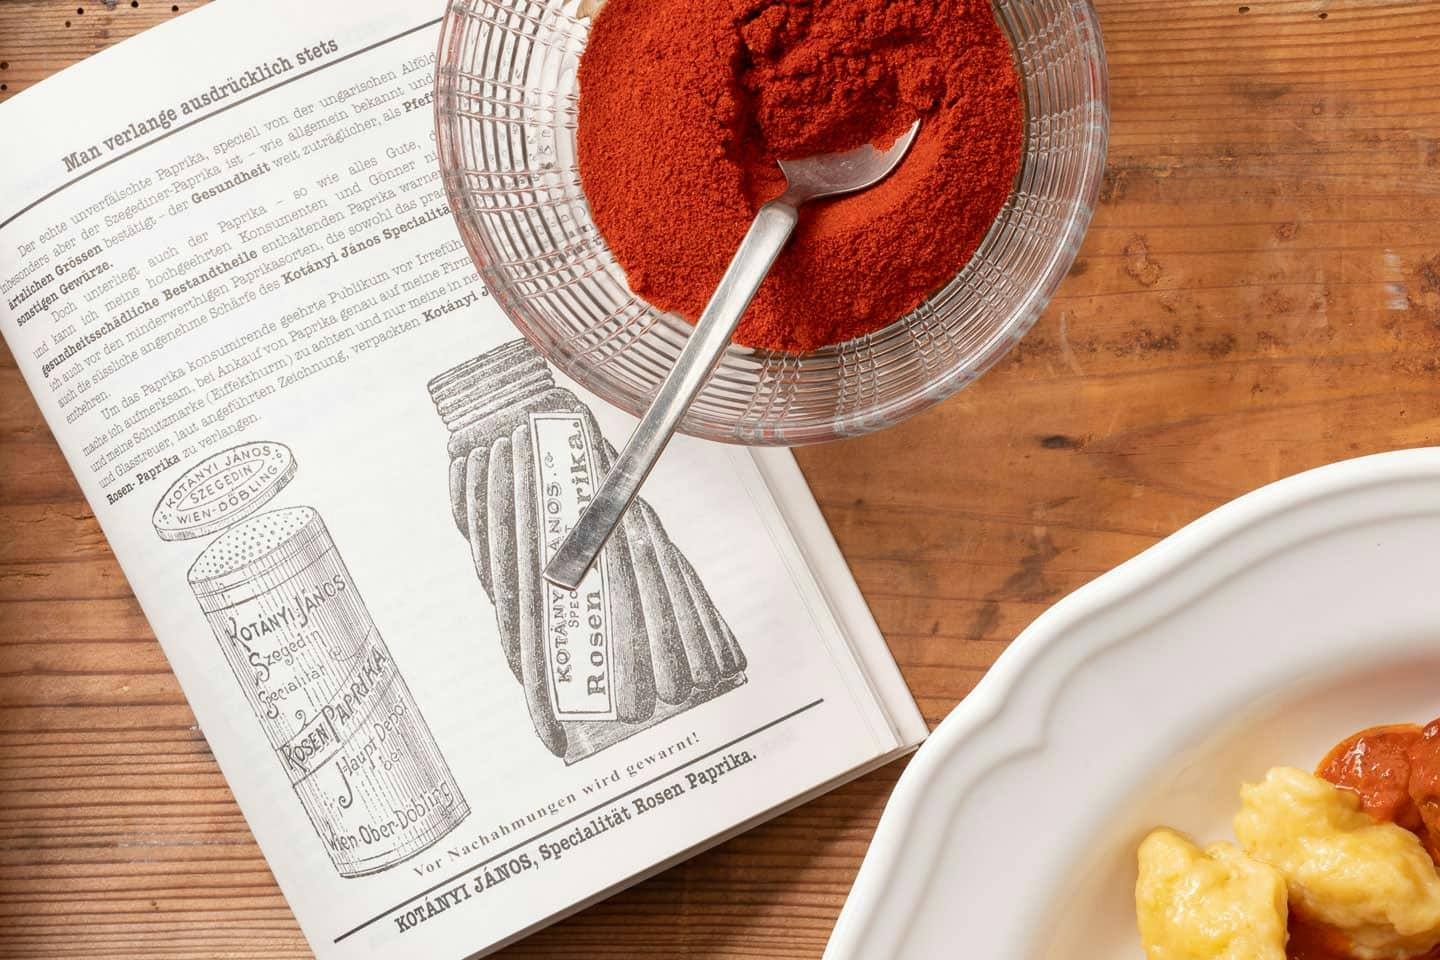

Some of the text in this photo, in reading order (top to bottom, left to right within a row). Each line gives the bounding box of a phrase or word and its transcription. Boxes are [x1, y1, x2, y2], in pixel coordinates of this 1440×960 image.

[17, 240, 36, 258] Der
[39, 222, 68, 244] echte
[70, 178, 152, 224] unverfälschte
[155, 153, 209, 180] Paprika,
[213, 126, 261, 155] speciell
[264, 116, 289, 131] von
[293, 104, 314, 118] der
[319, 72, 397, 108] ungarischen
[52, 238, 76, 257] aber
[81, 224, 100, 240] der
[104, 166, 222, 227] Szegediner-Paprika
[225, 155, 243, 168] ist
[260, 138, 284, 152] wie
[288, 110, 349, 141] allgemein
[351, 86, 404, 114] bekannt
[408, 72, 436, 90] und
[61, 39, 338, 173] Man verlange ausdrücklich stets
[32, 340, 50, 360] und
[50, 324, 77, 345] kann
[81, 310, 99, 326] ich
[104, 288, 140, 312] meine
[145, 242, 232, 288] hochgeehrten
[238, 200, 328, 244] Konsumenten
[335, 182, 362, 200] und
[368, 161, 415, 186] Gönner
[50, 302, 78, 324] Doch
[83, 266, 140, 302] unterliegt
[148, 248, 179, 268] auch
[188, 232, 208, 247] der
[216, 206, 267, 233] Paprika
[293, 188, 308, 199] so
[316, 173, 340, 188] wie
[348, 157, 378, 176] alles
[386, 142, 421, 159] Gute,
[54, 245, 104, 276] Grössen
[102, 216, 156, 248] bestätigt
[168, 200, 189, 216] der
[191, 162, 271, 204] Gesundheit
[272, 150, 300, 167] weit
[382, 108, 402, 122] als
[16, 262, 114, 328] sonstigen Gewürze.
[42, 298, 160, 378] gesundheitsschädliche
[161, 250, 258, 301] Bestandtheile
[262, 212, 345, 253] enthaltenden
[346, 190, 397, 215] Paprika
[49, 377, 63, 392] ich
[62, 362, 84, 382] auch
[83, 352, 101, 366] vor
[104, 338, 125, 355] den
[326, 231, 346, 245] die
[348, 208, 394, 236] sowohl
[395, 200, 418, 215] das
[58, 388, 78, 408] auch
[77, 379, 92, 394] die
[140, 315, 208, 356] angenehme
[209, 291, 256, 319] Schärfe
[259, 280, 280, 295] des
[280, 252, 339, 285] Kotányi
[340, 235, 381, 258] János
[100, 405, 120, 420] Um
[122, 392, 140, 408] das
[140, 368, 186, 397] Paprika
[186, 322, 277, 372] konsumirende
[280, 300, 326, 328] geehrte
[328, 272, 391, 304] Publikum
[392, 260, 413, 275] vor
[108, 424, 124, 439] ich
[124, 386, 195, 429] aufmerksam,
[194, 372, 216, 388] bei
[218, 347, 262, 378] Ankauf
[263, 338, 288, 354] von
[288, 315, 338, 342] Paprika
[340, 297, 378, 322] genau
[379, 284, 400, 302] auf
[401, 270, 440, 292] meine
[66, 392, 111, 424] entbehren.
[90, 454, 108, 472] und
[105, 440, 133, 462] meine
[132, 399, 205, 444] Schutzmarke
[294, 348, 312, 360] zu
[312, 328, 355, 352] achten
[355, 312, 382, 332] und
[382, 304, 406, 320] nur
[408, 286, 446, 308] meine
[447, 280, 462, 292] in
[98, 470, 116, 488] und
[114, 438, 174, 477] Glasstreuer,
[173, 422, 199, 441] laut
[201, 385, 276, 427] angeführten
[277, 350, 349, 388] Zeichnung,
[350, 318, 421, 353] verpackten
[421, 290, 479, 323] Kotányi
[136, 454, 181, 486] Paprika
[182, 445, 198, 458] zu
[198, 414, 263, 448] verlangen.
[190, 464, 253, 504] SZEGEDIN
[249, 630, 327, 687] Szegedin
[551, 590, 572, 684] KOTÁNY
[587, 589, 606, 696] Rosen
[394, 750, 757, 933] KOTÁNYI JÁNOS, Specialität Rosen Paprika.
[413, 731, 700, 878] Vor Nachahmungen wird gewarnt!
